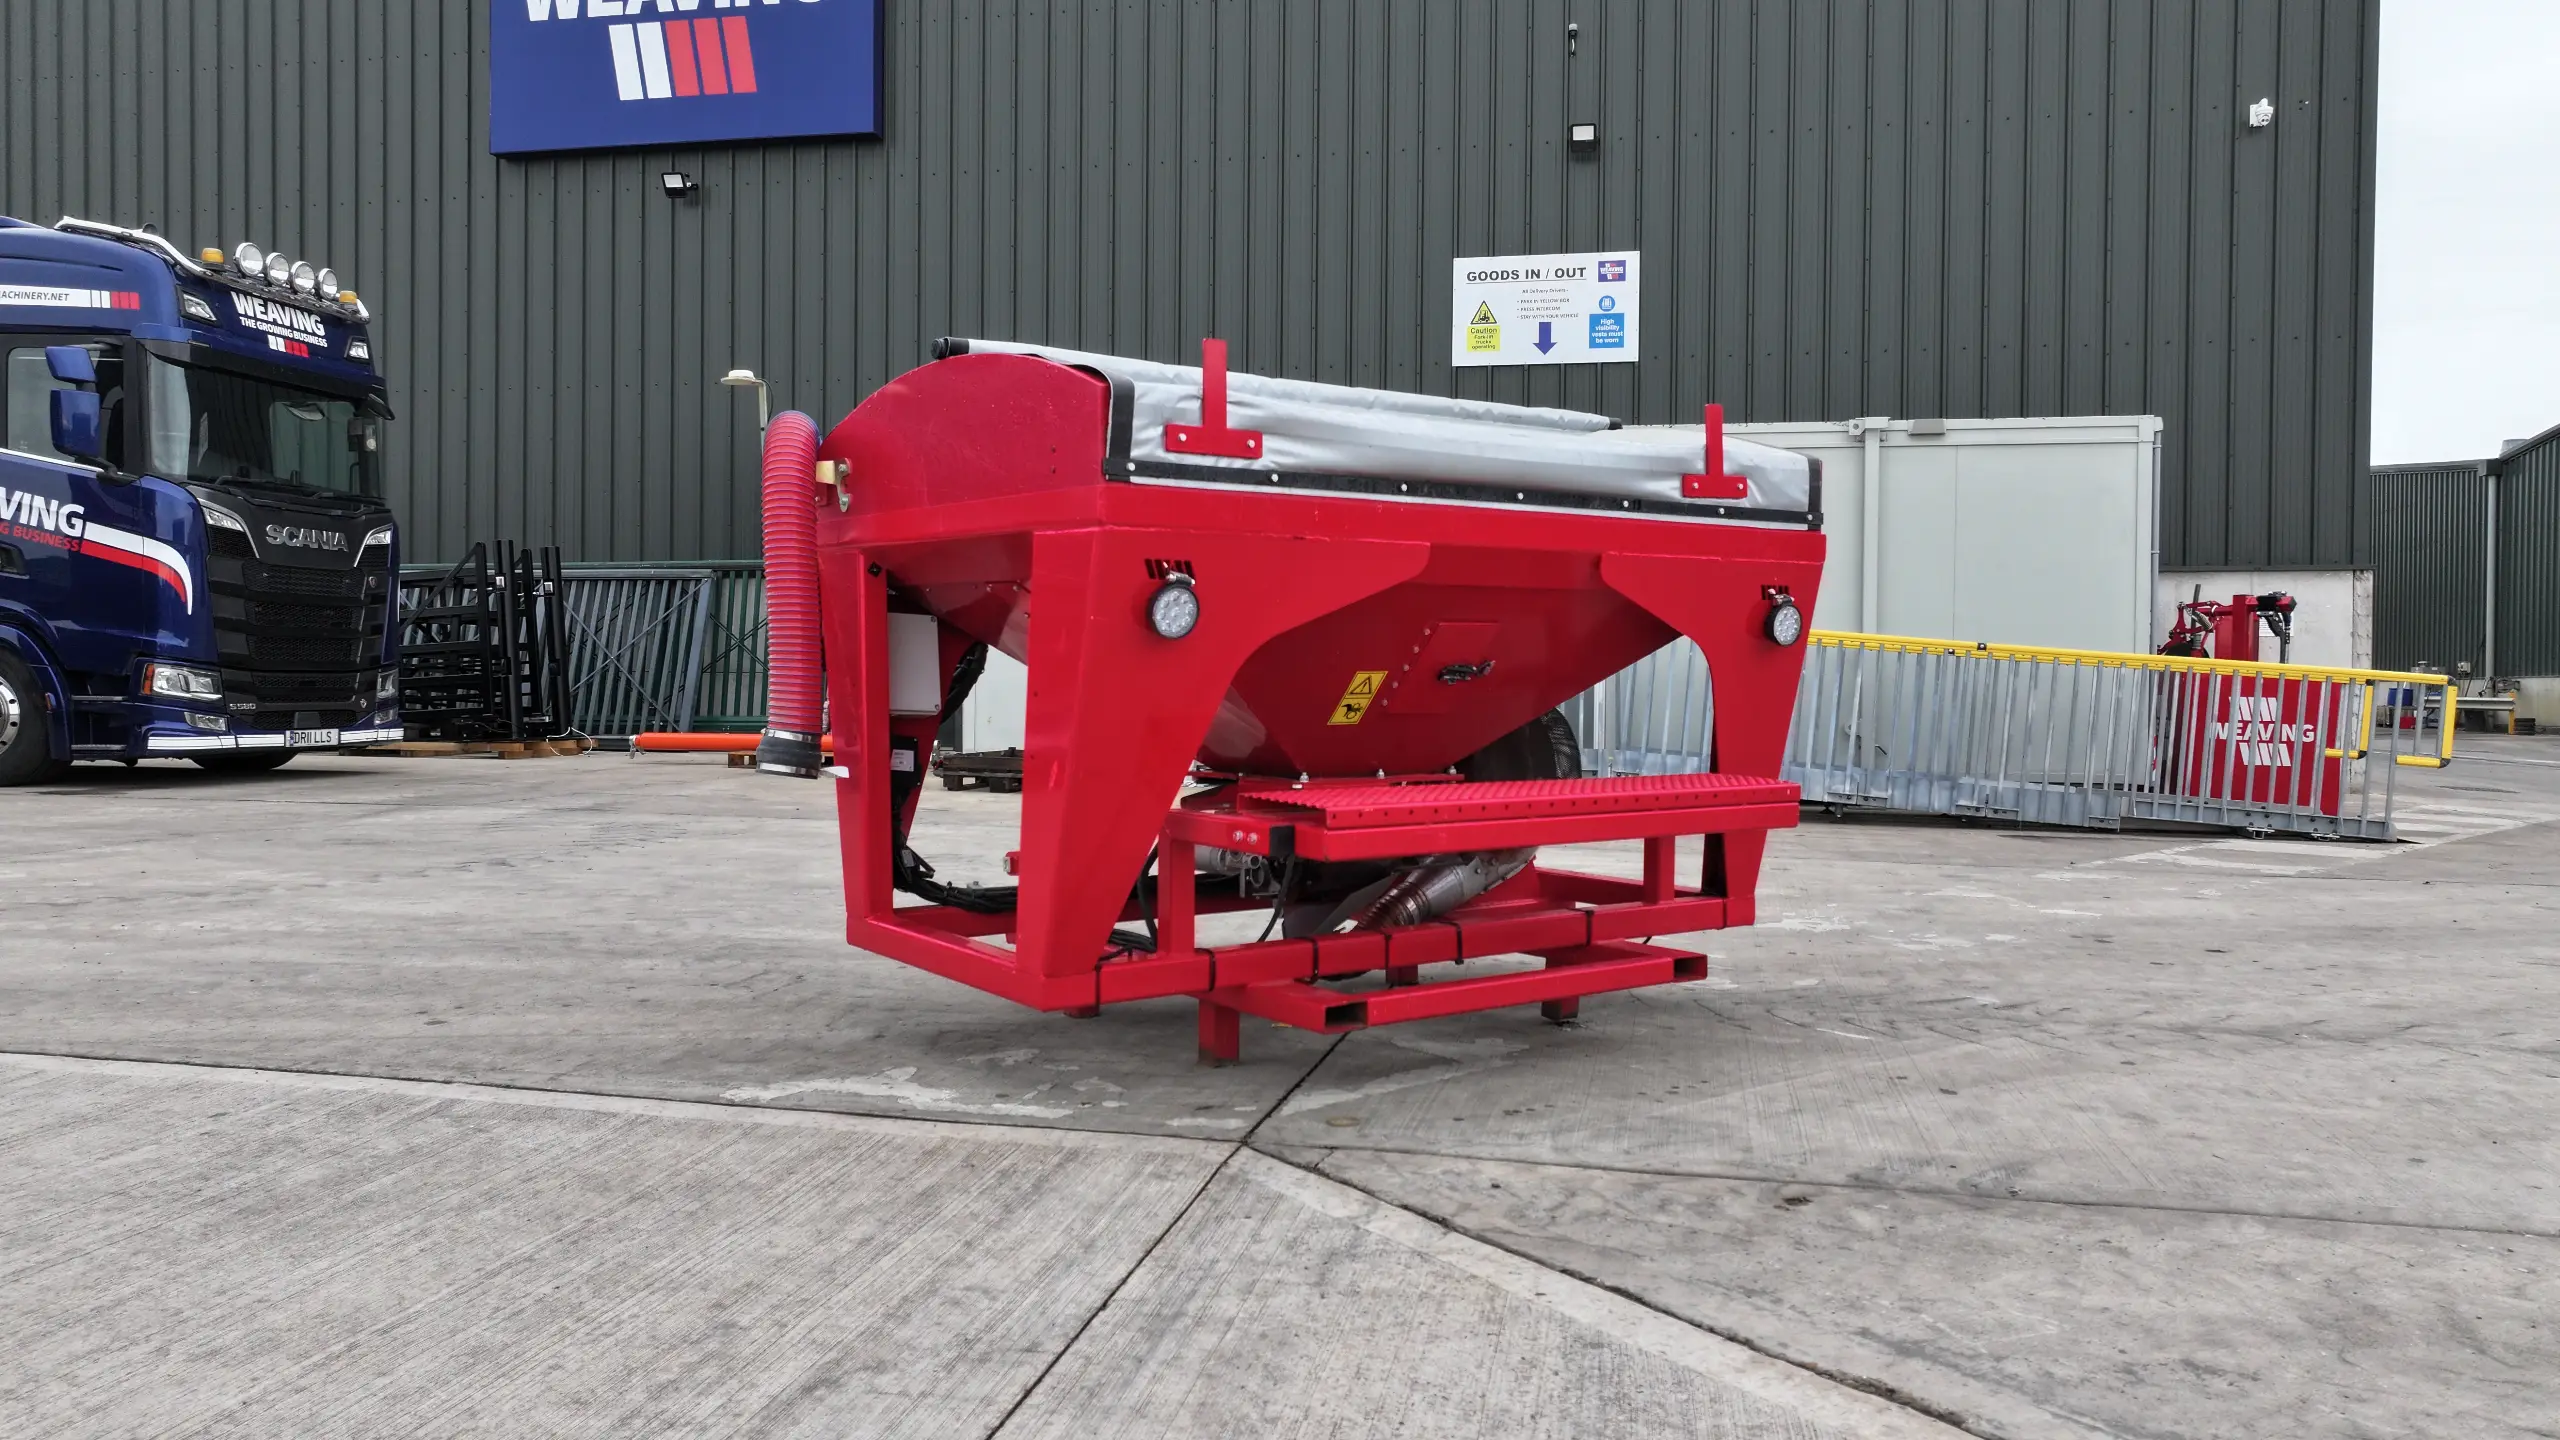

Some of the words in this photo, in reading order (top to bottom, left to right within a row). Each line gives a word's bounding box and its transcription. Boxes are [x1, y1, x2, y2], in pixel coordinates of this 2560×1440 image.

[1466, 270, 1520, 281] GOODS
[1525, 269, 1541, 280] IN
[1545, 268, 1550, 279] /
[1554, 267, 1587, 279] OUT
[0, 290, 69, 301] ACHINERY.NET
[230, 290, 325, 336] WEAVING
[239, 316, 257, 329] THE
[256, 321, 293, 338] GROWING
[293, 330, 327, 347] BUSINESS
[13, 525, 80, 552] BUSINESS
[265, 524, 349, 552] SCANIA
[314, 731, 332, 744] LLS
[2212, 721, 2315, 743] WEAVNG
